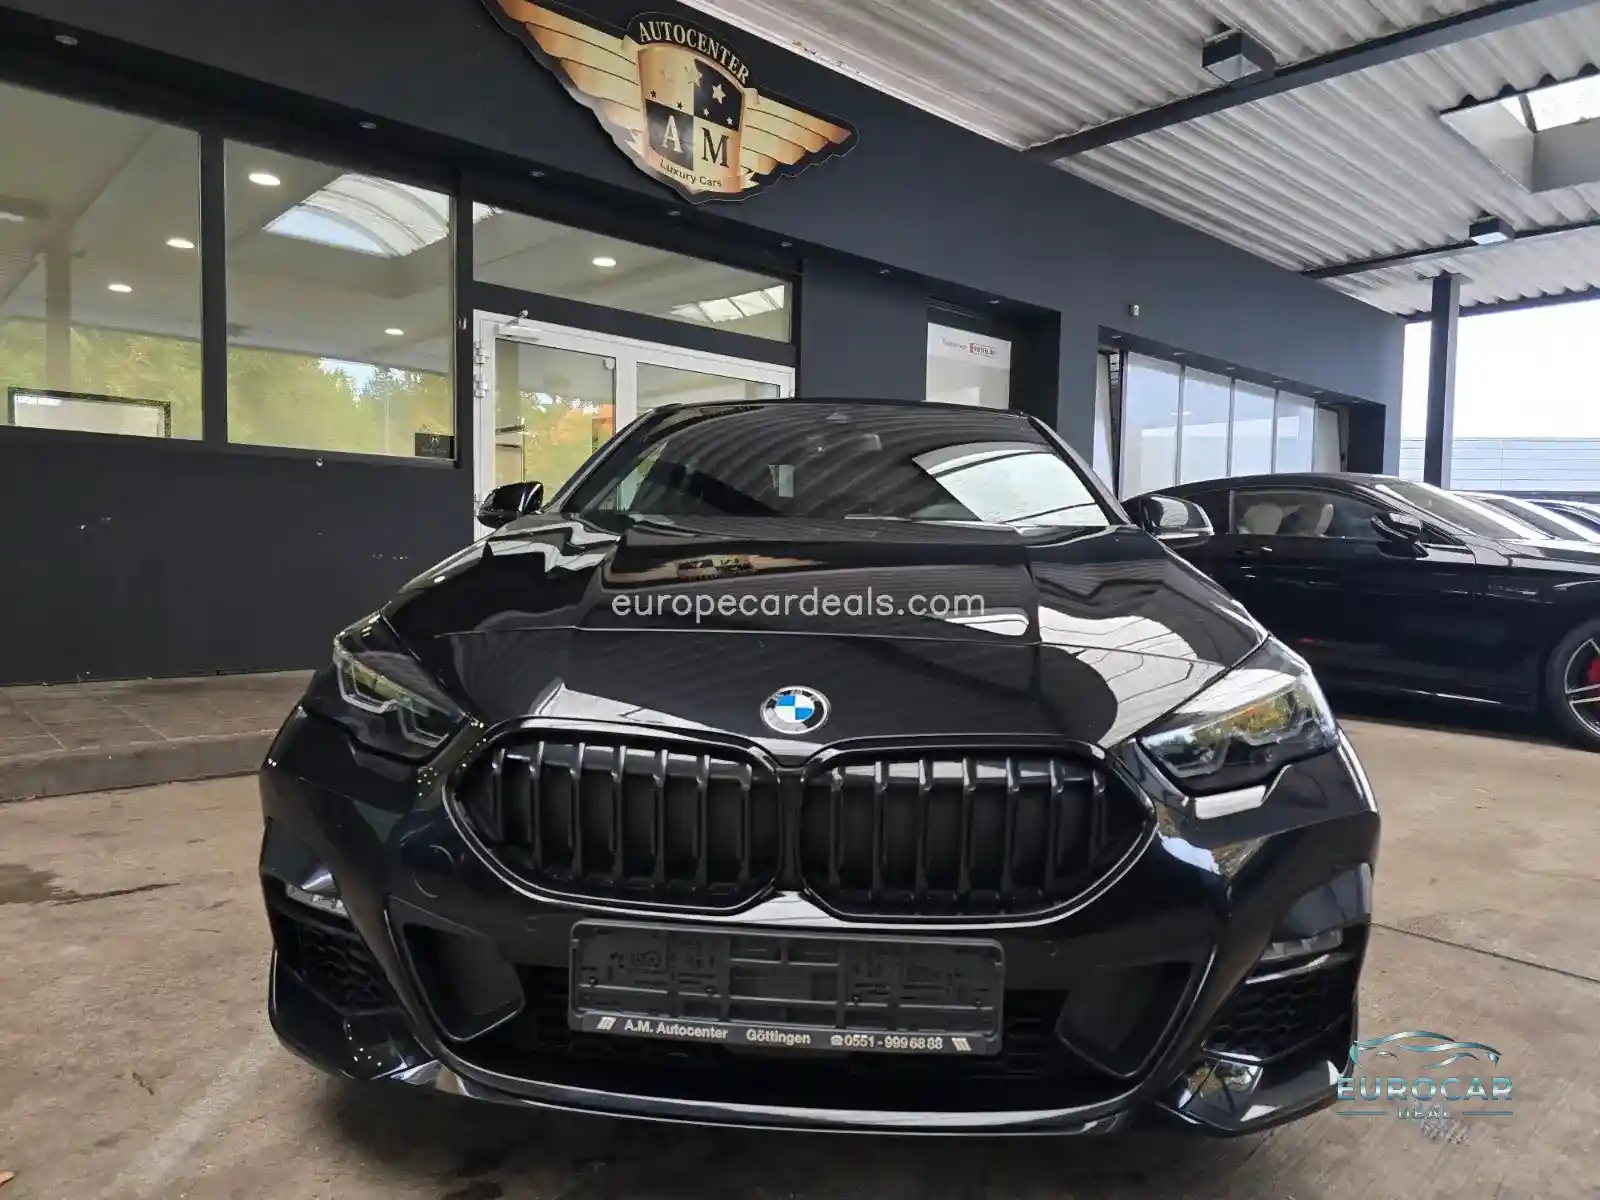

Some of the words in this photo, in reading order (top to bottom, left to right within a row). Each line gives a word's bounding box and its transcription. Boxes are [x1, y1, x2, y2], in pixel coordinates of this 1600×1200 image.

[639, 20, 749, 85] AUTOCENTER
[660, 114, 683, 154] A
[701, 126, 729, 168] M
[660, 158, 697, 185] Luxury
[699, 175, 722, 188] Cars
[624, 1018, 654, 1033] A.M.
[656, 1021, 729, 1040] Autocenter
[746, 1028, 811, 1045] Göttingen
